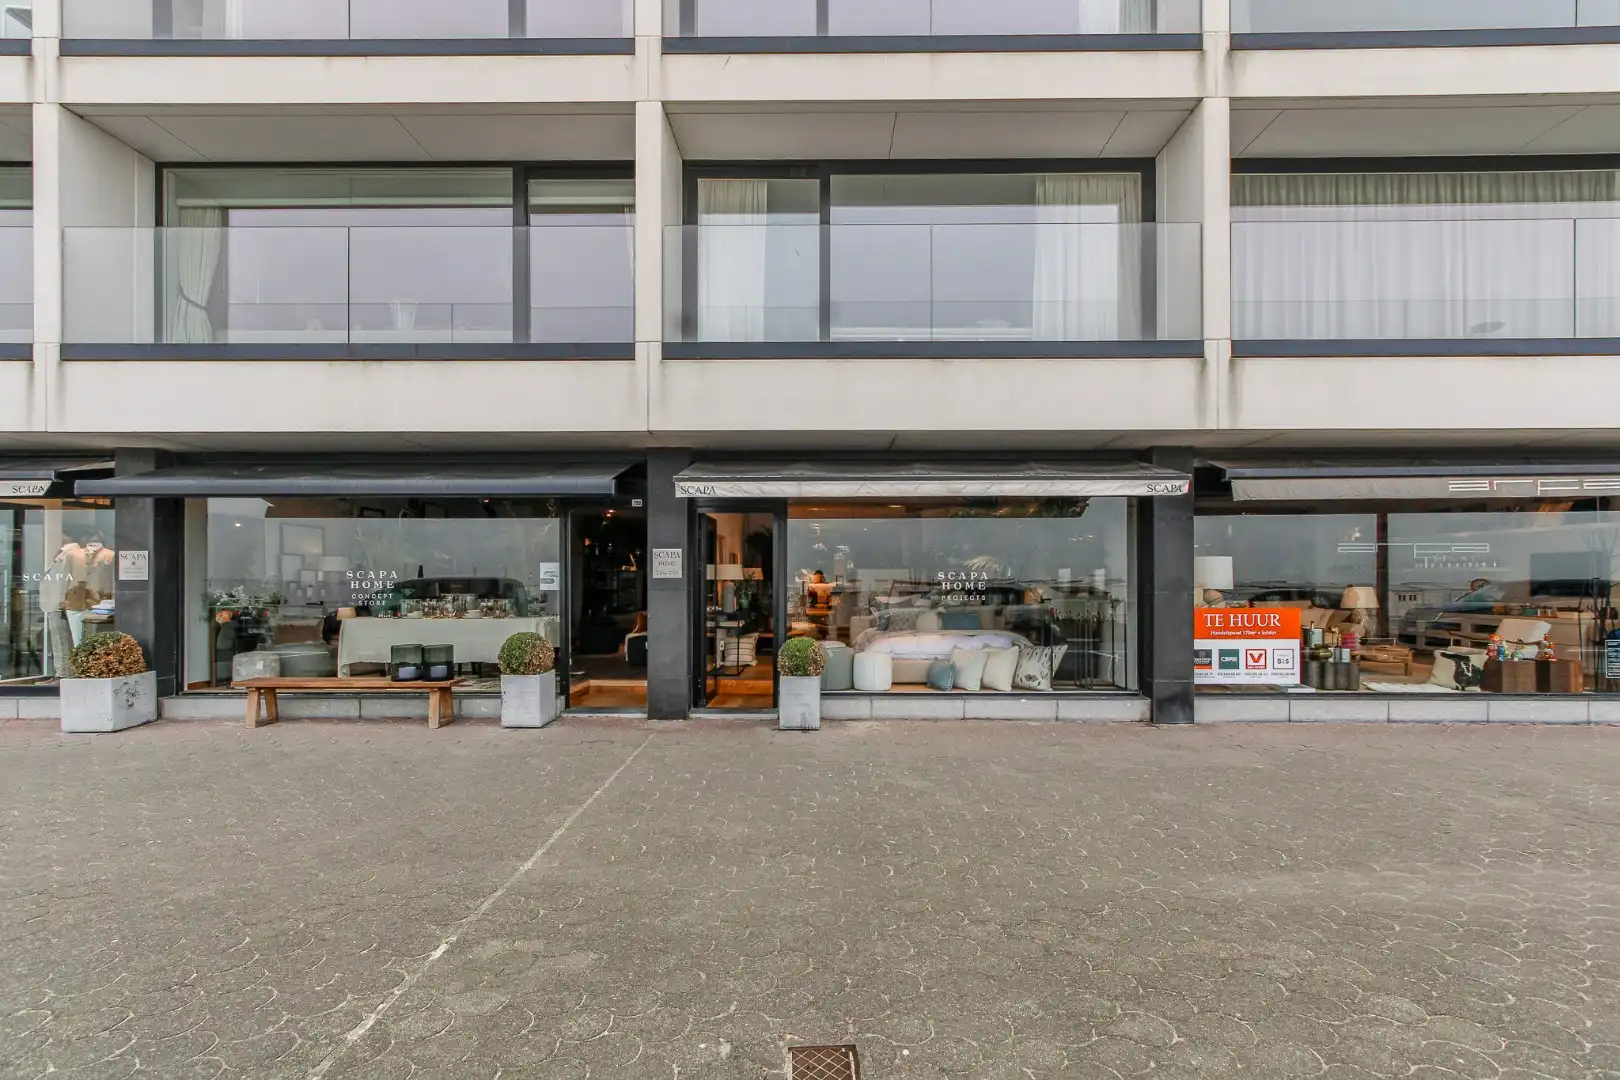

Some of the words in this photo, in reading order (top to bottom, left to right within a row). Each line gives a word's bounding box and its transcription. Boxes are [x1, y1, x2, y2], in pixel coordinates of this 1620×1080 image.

[12, 485, 46, 494] SCAPA
[680, 485, 717, 495] SCAPA
[1146, 483, 1183, 493] SCAPA
[653, 551, 681, 559] SCAPA
[23, 573, 74, 581] SCAPA
[346, 570, 398, 579] SCAPA
[937, 571, 988, 580] SCAPA
[350, 580, 395, 589] HOME
[942, 581, 986, 590] HOME
[1203, 613, 1225, 627] TE
[1229, 613, 1281, 627] HUUR
